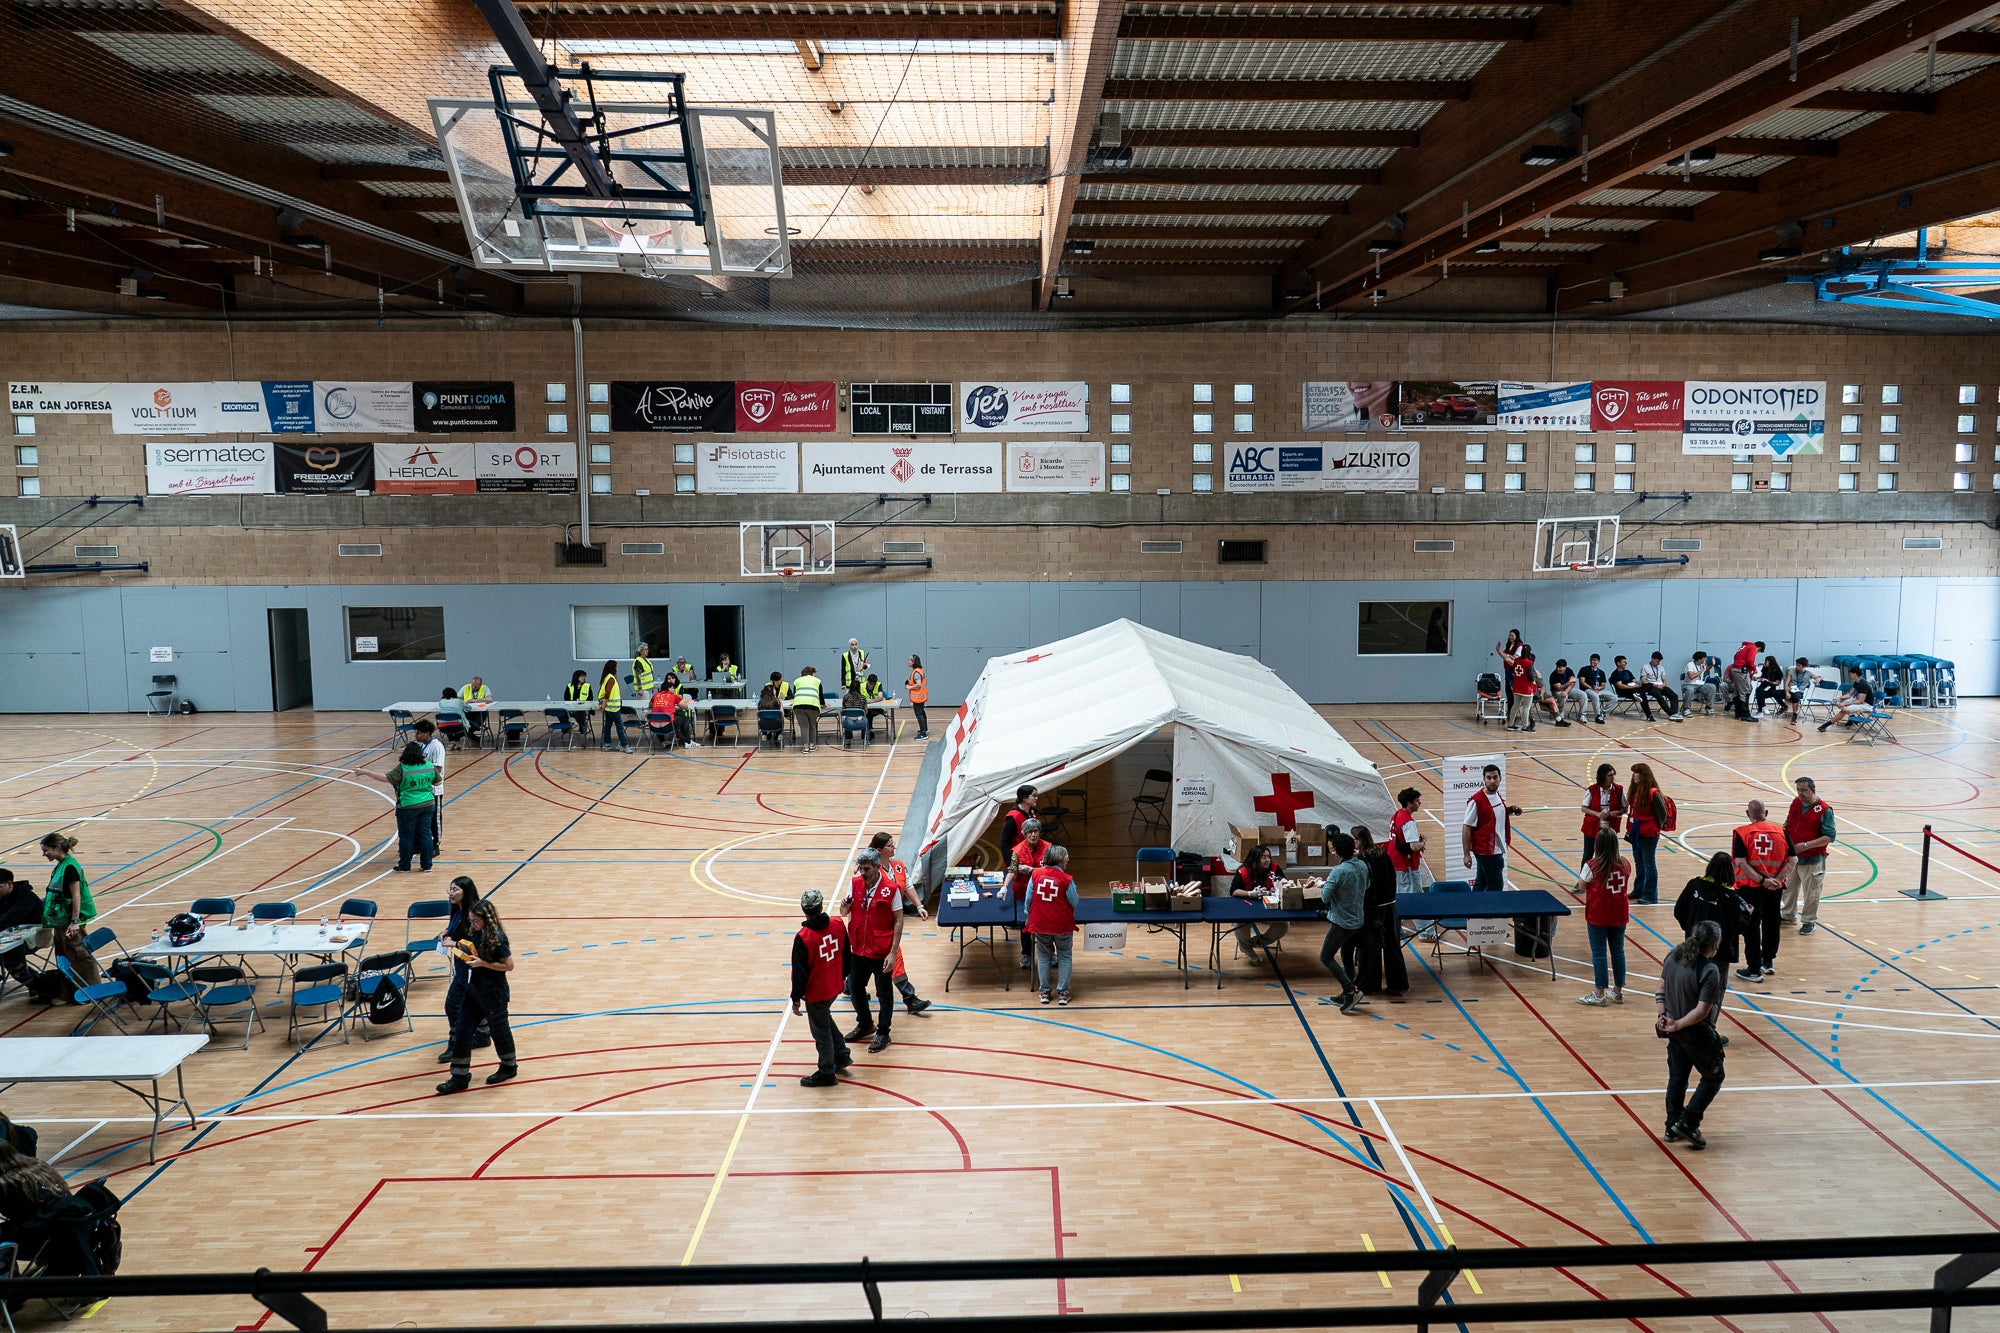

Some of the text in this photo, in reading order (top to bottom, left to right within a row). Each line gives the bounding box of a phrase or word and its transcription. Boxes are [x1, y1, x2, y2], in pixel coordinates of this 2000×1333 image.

[11, 385, 42, 394] Z.E.M.
[1329, 387, 1346, 396] 15%
[440, 395, 468, 404] PUNT
[476, 395, 505, 404] COMA
[782, 392, 797, 402] Tots
[1012, 391, 1034, 402] Vine
[1044, 390, 1068, 403] jugar
[1636, 392, 1650, 401] Tots
[1692, 388, 1818, 412] ODONTOMED
[12, 401, 112, 410] BAR CAN JOFRESA
[635, 386, 654, 423] Al
[784, 400, 830, 414] Vermells !!
[965, 387, 1008, 424] jet
[1020, 402, 1037, 412] amb
[1311, 404, 1340, 413] SOCIS
[1637, 399, 1680, 413] Vermells !!
[131, 407, 196, 418] VOLTTIUM
[164, 446, 265, 462] sermatec
[719, 446, 786, 460] Fisiotastic
[1230, 447, 1274, 472] ABC
[1348, 453, 1410, 467] ZURITO
[390, 468, 458, 477] HERCAL
[812, 464, 993, 476] Ajuntament de Terrassa
[168, 480, 183, 488] amb
